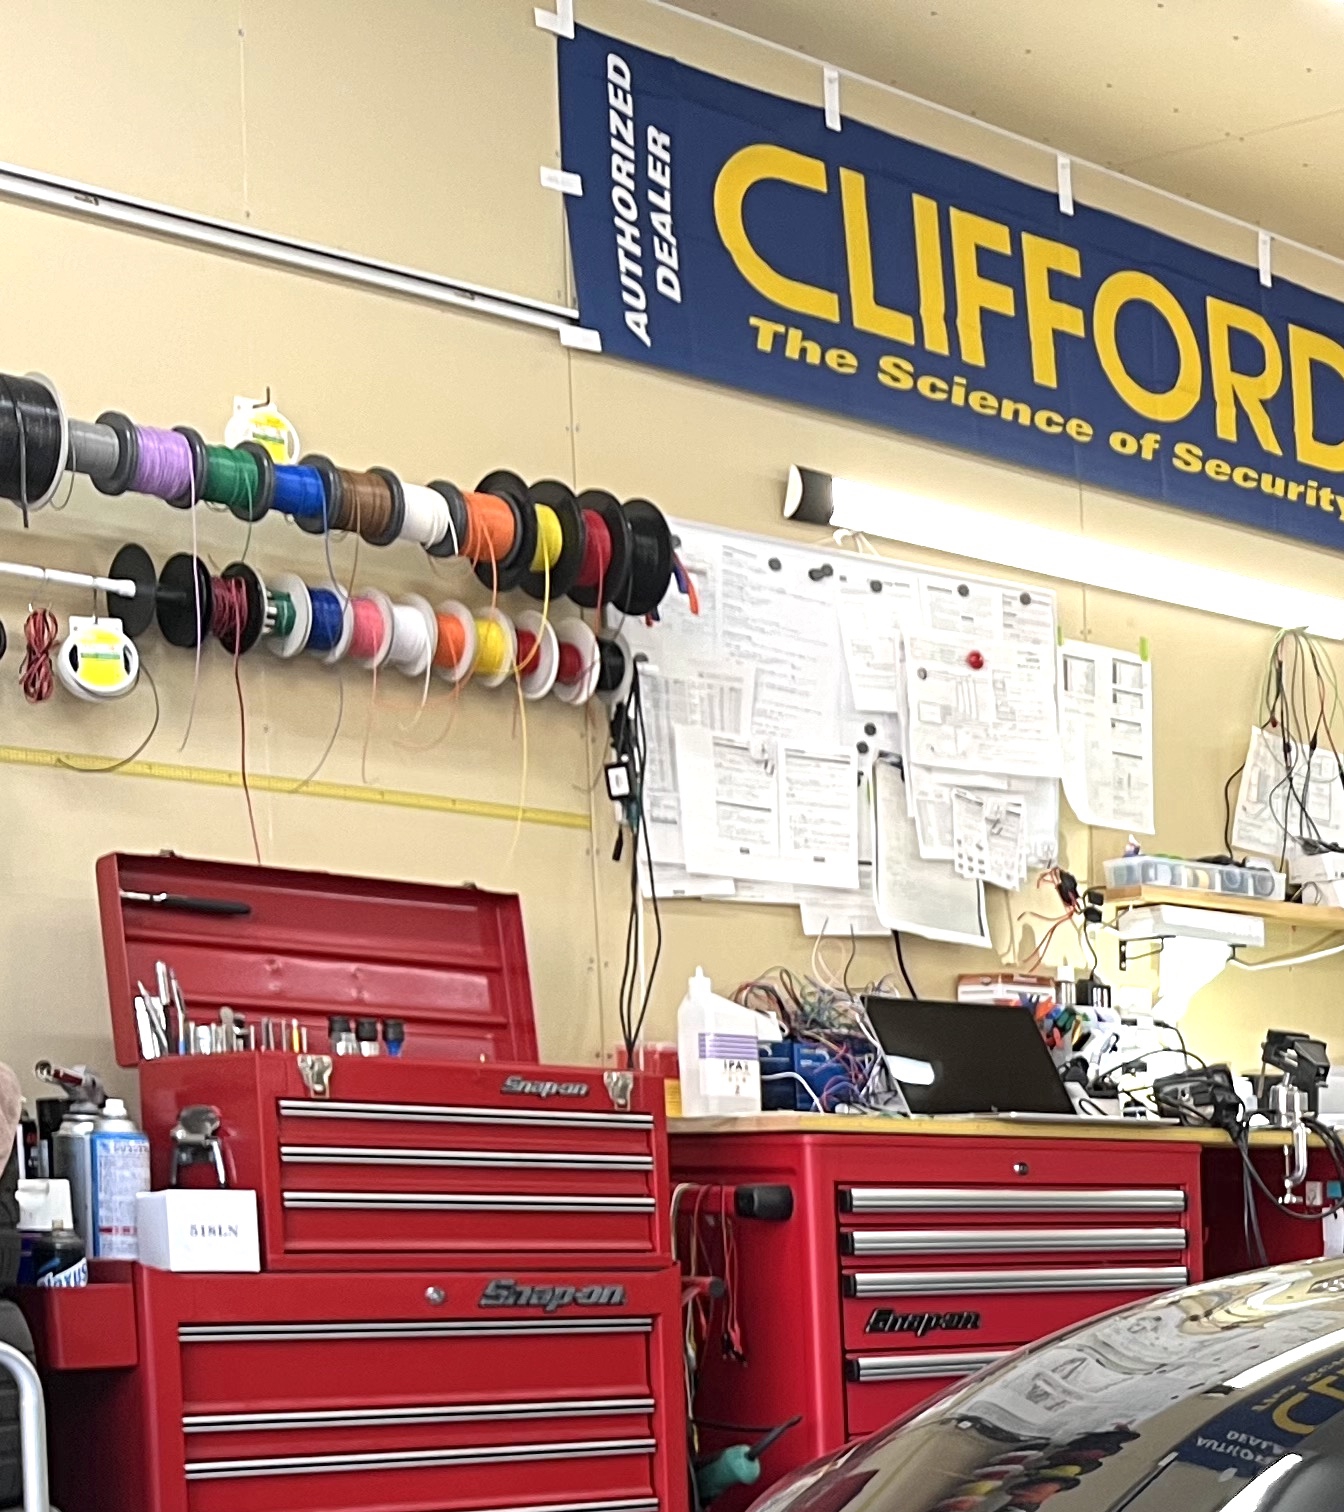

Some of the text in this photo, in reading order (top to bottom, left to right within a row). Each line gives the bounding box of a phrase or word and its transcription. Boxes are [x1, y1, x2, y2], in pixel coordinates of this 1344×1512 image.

[606, 52, 652, 348] AUTHORIZED
[647, 124, 682, 304] DEALER
[748, 316, 858, 375] The
[877, 354, 1094, 442] Science
[1109, 429, 1161, 470] of
[502, 1075, 590, 1098] Snap-on
[478, 1278, 626, 1314] Snap-on
